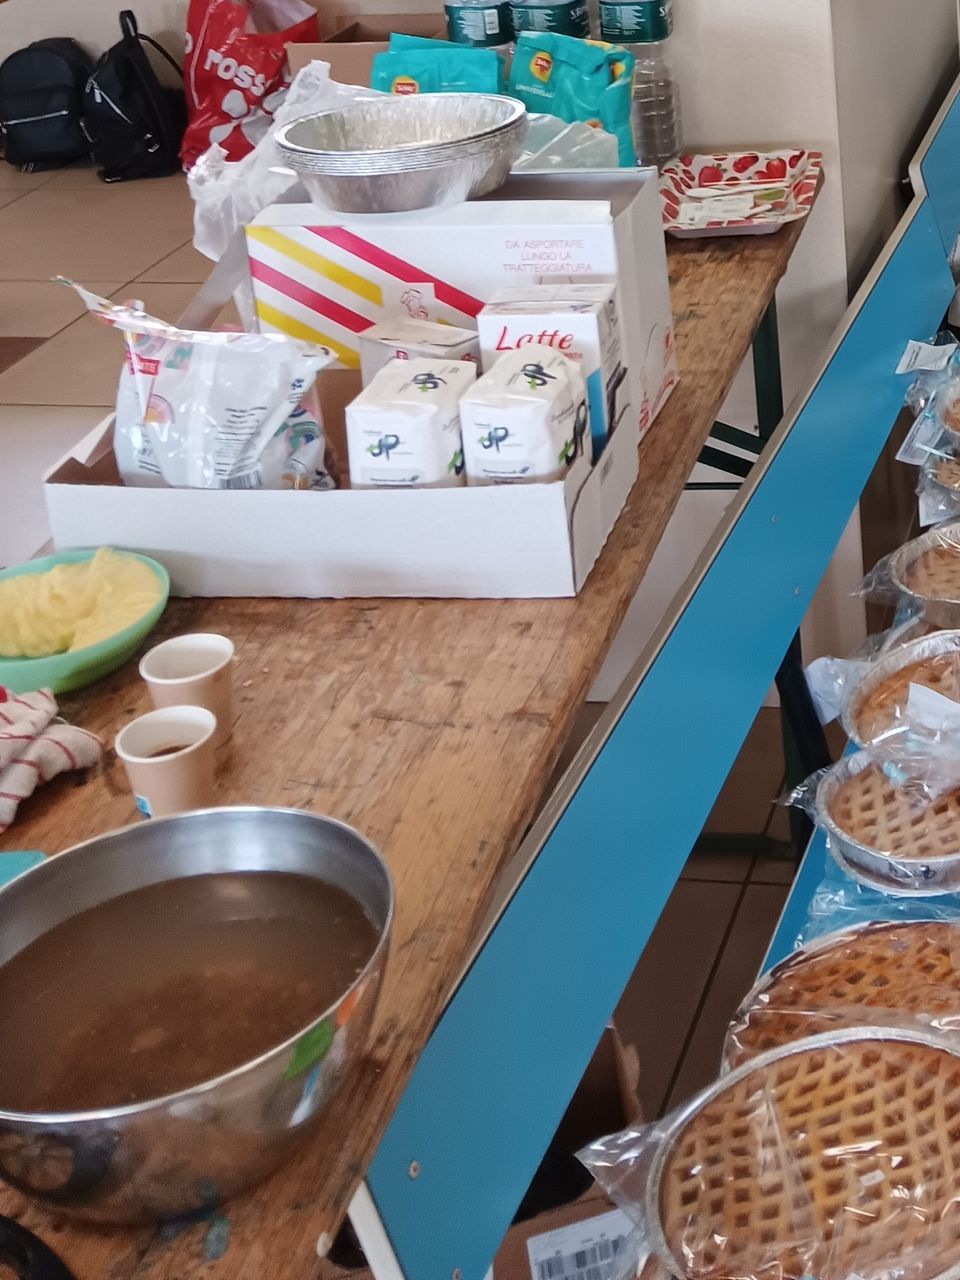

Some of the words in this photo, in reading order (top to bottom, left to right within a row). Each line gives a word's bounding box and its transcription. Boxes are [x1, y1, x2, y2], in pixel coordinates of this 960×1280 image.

[505, 240, 520, 249] DA
[524, 239, 585, 249] ASPORTARE
[521, 251, 558, 261] LUNGO
[560, 251, 573, 261] LA
[502, 263, 593, 273] TRATTEGGIATURA
[495, 325, 575, 351] Latte
